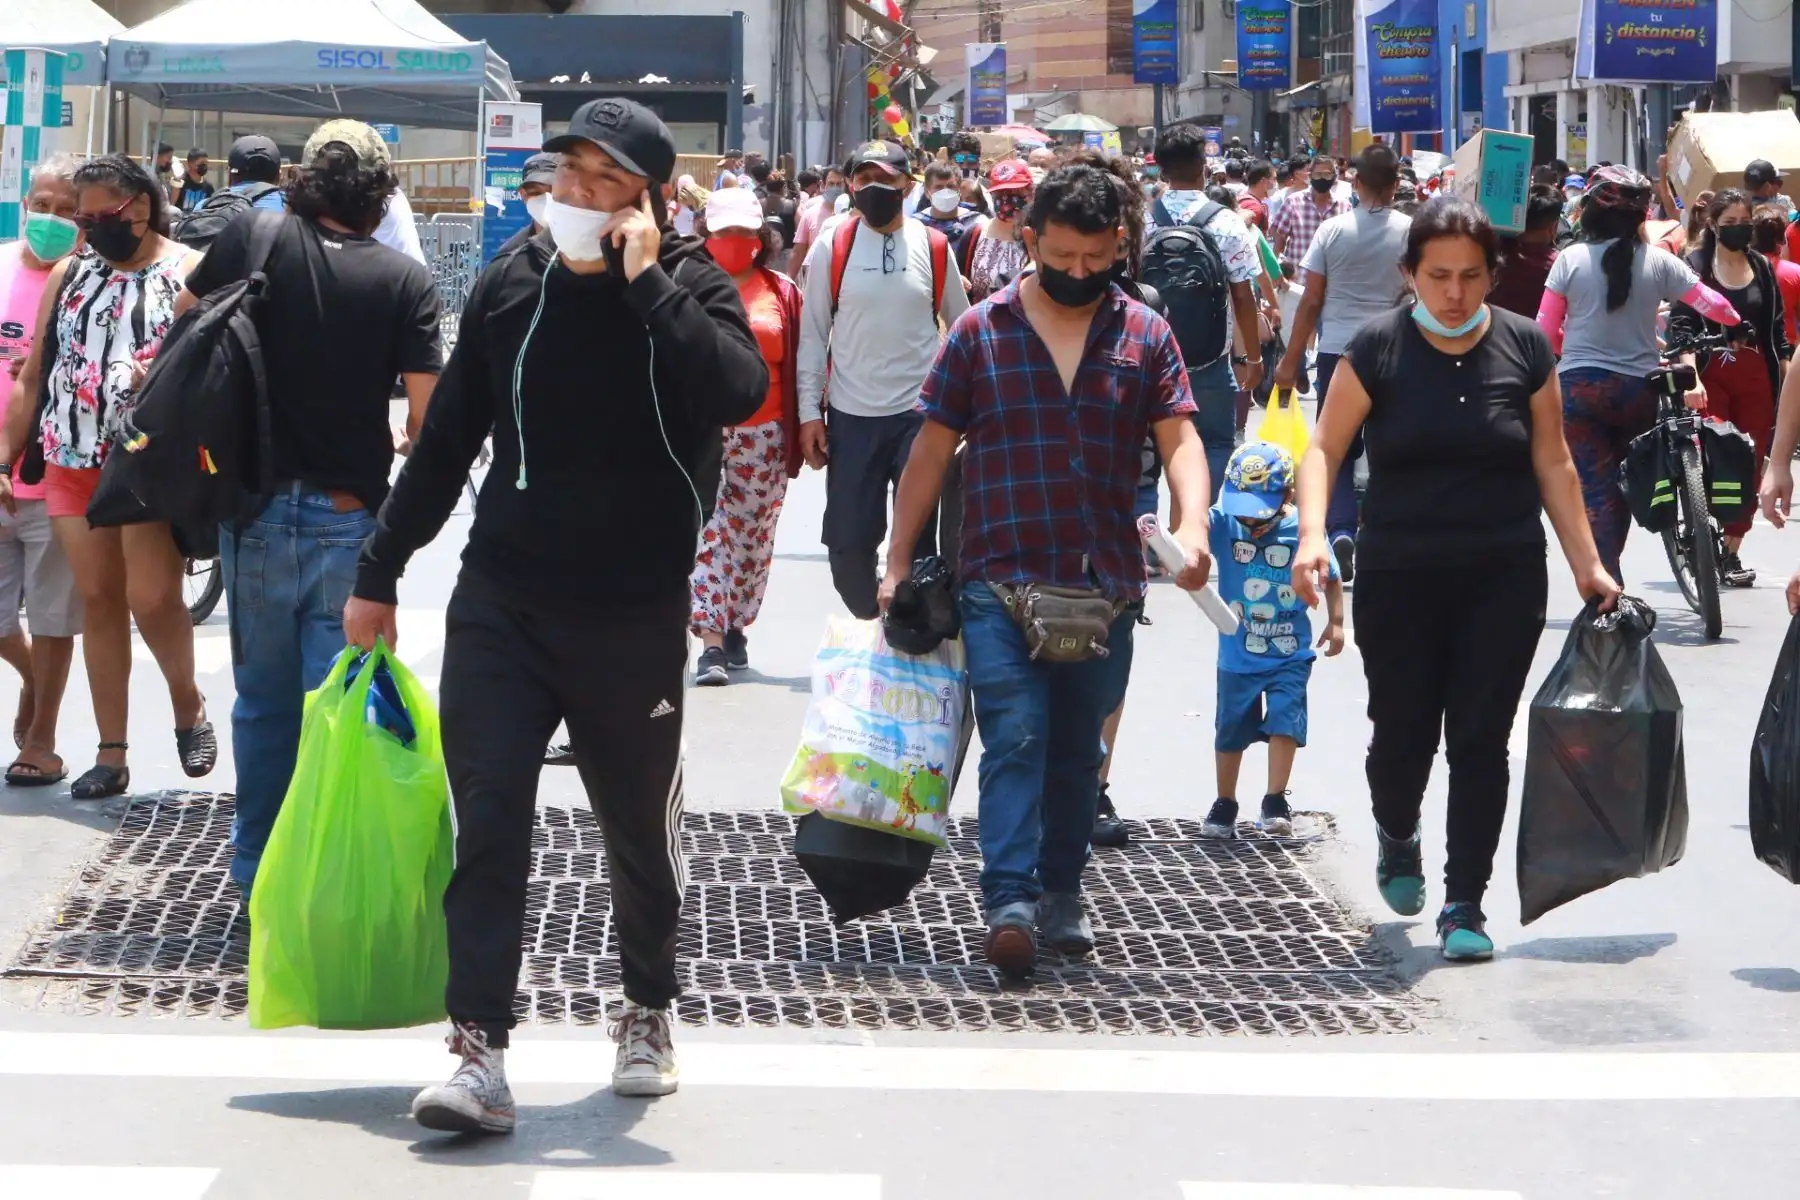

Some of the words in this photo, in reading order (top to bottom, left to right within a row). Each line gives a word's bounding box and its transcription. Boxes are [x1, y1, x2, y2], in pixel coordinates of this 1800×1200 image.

[1651, 13, 1662, 21] tu
[1371, 22, 1432, 41] Compra
[1617, 24, 1696, 39] distancia
[317, 49, 391, 70] SISOL
[395, 50, 471, 71] SALUD
[1383, 95, 1430, 106] distancia
